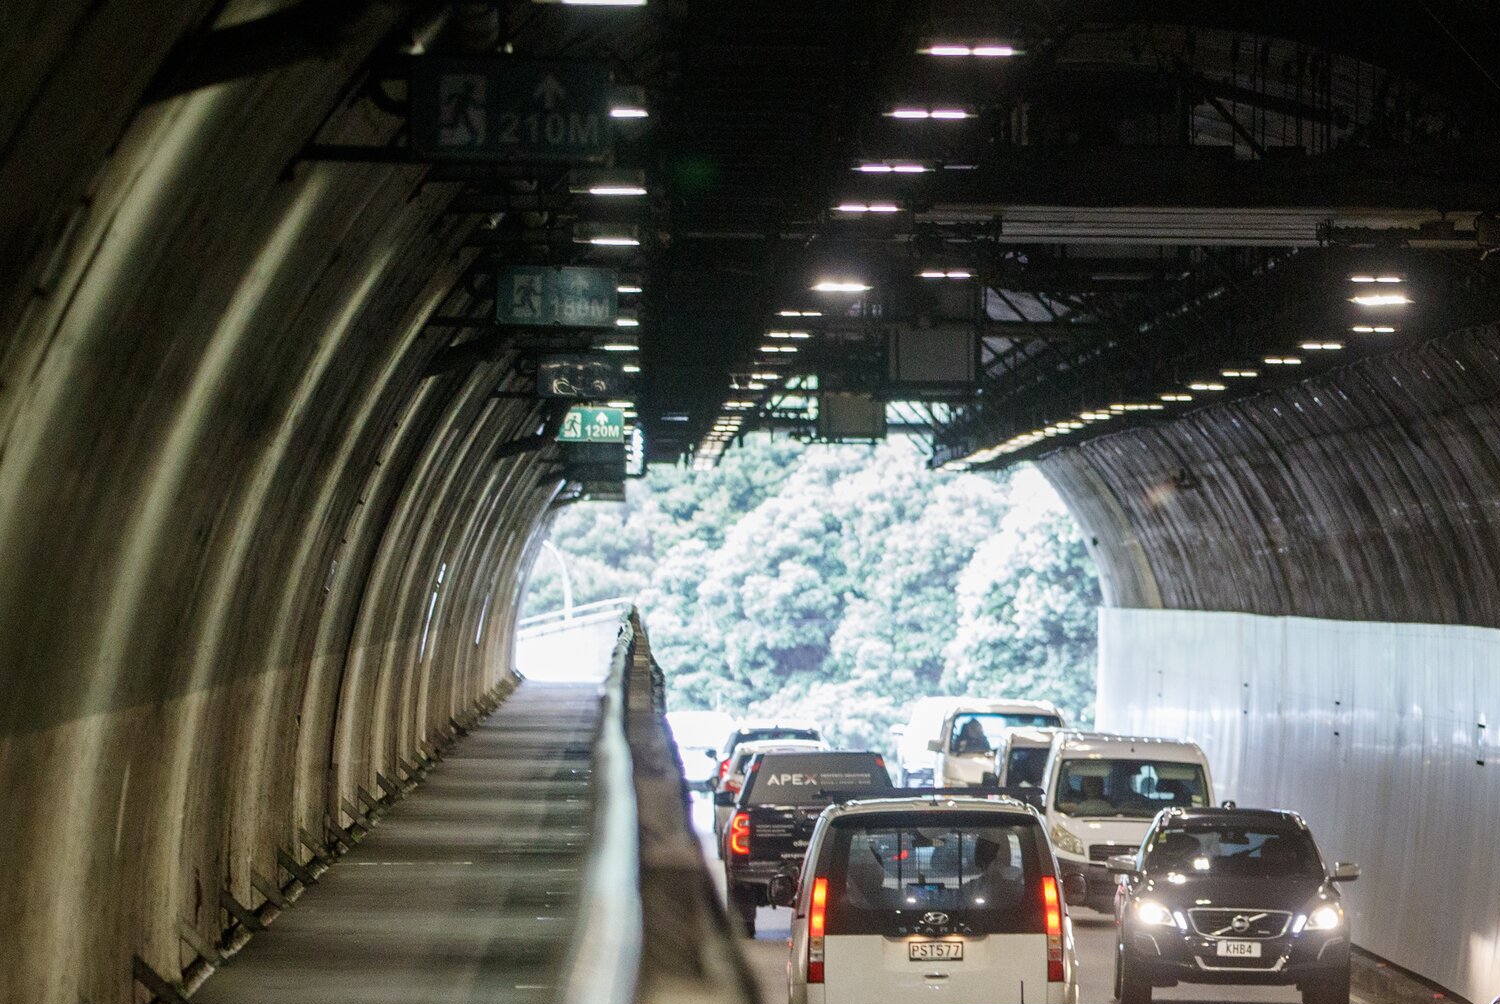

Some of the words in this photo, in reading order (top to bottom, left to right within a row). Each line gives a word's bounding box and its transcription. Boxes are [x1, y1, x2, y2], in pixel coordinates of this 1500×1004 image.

[498, 111, 600, 145] 210M
[585, 424, 619, 437] 120M
[767, 773, 819, 786] APEX
[911, 944, 960, 957] PST577
[1226, 943, 1252, 955] KHB4
